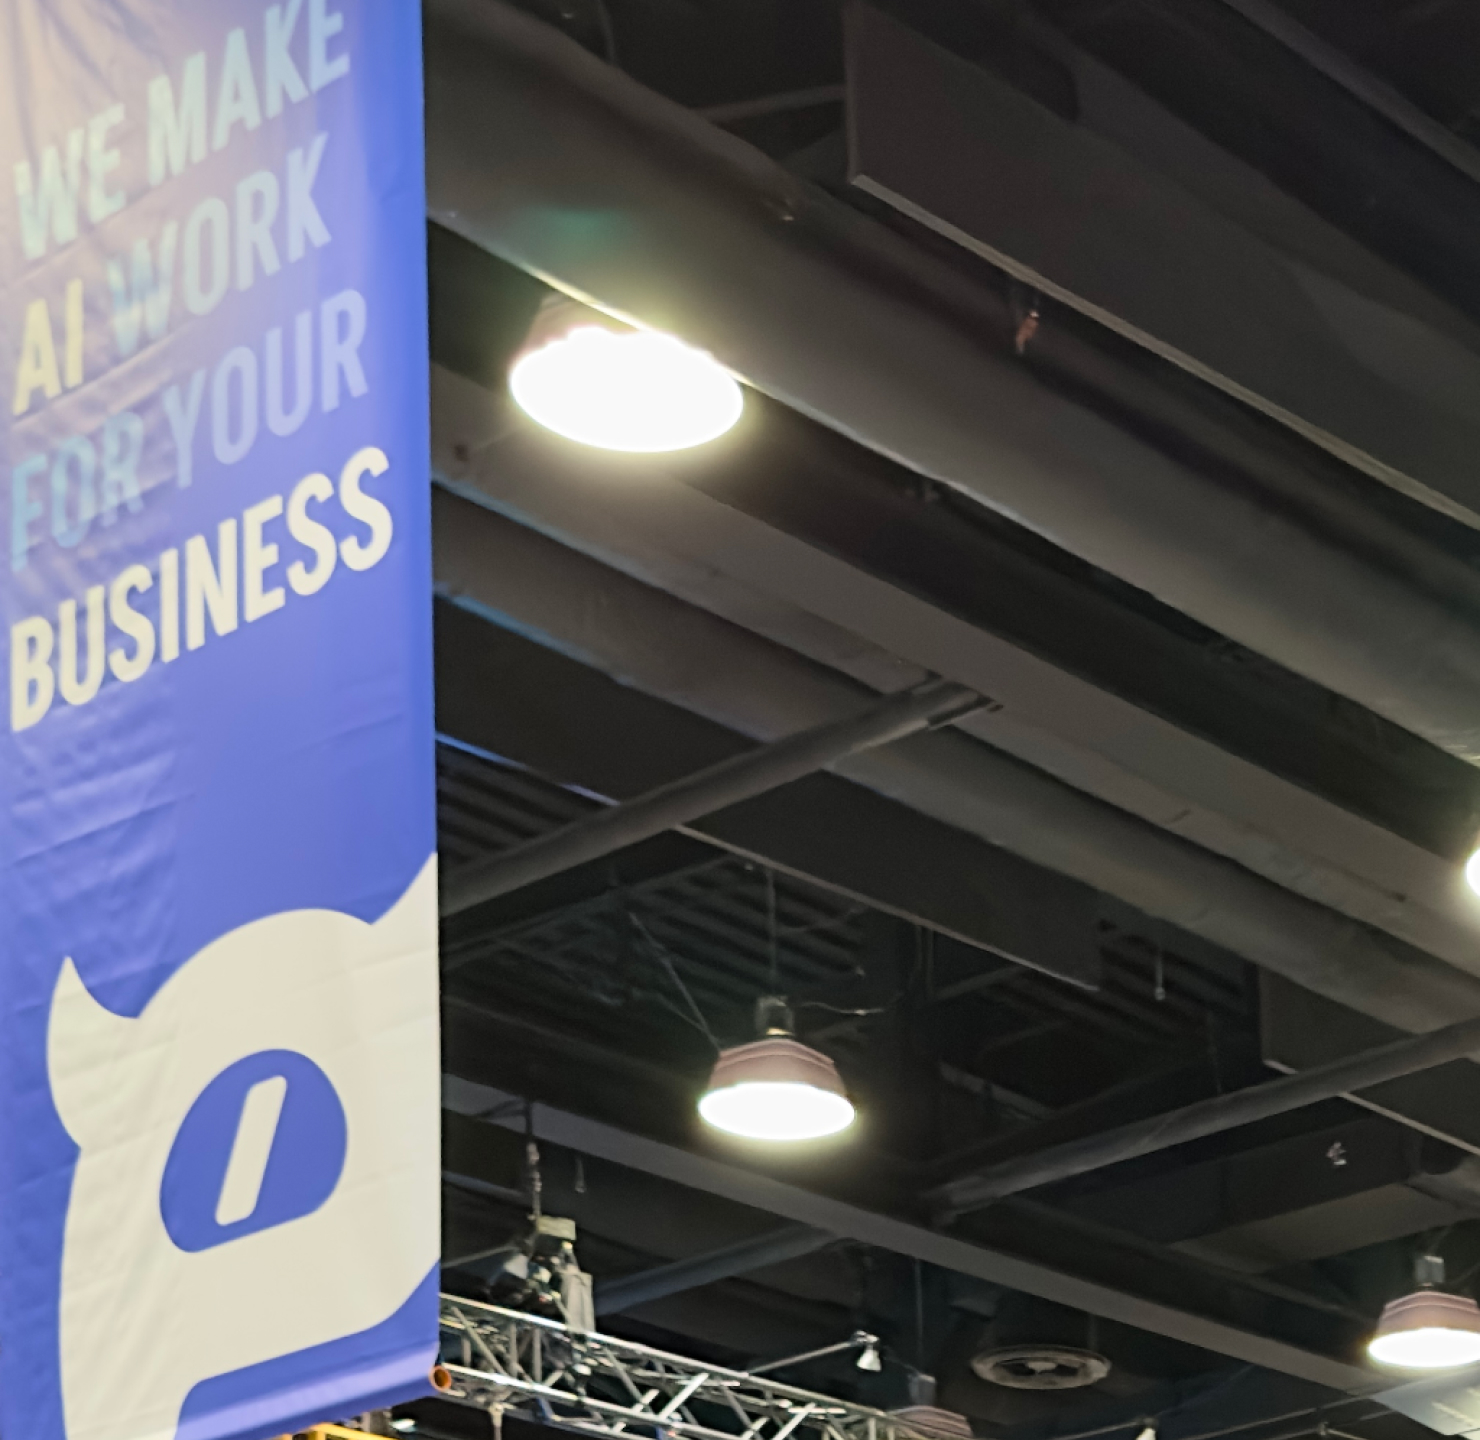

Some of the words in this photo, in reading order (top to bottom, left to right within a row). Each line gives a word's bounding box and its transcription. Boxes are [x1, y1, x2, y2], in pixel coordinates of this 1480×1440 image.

[12, 103, 126, 260] WE
[148, 0, 350, 187] MAKE
[12, 279, 84, 416] AI
[107, 132, 332, 357] WORK
[10, 409, 144, 572] FOR
[160, 288, 369, 489] YOUR
[11, 446, 393, 732] BUSINESS
